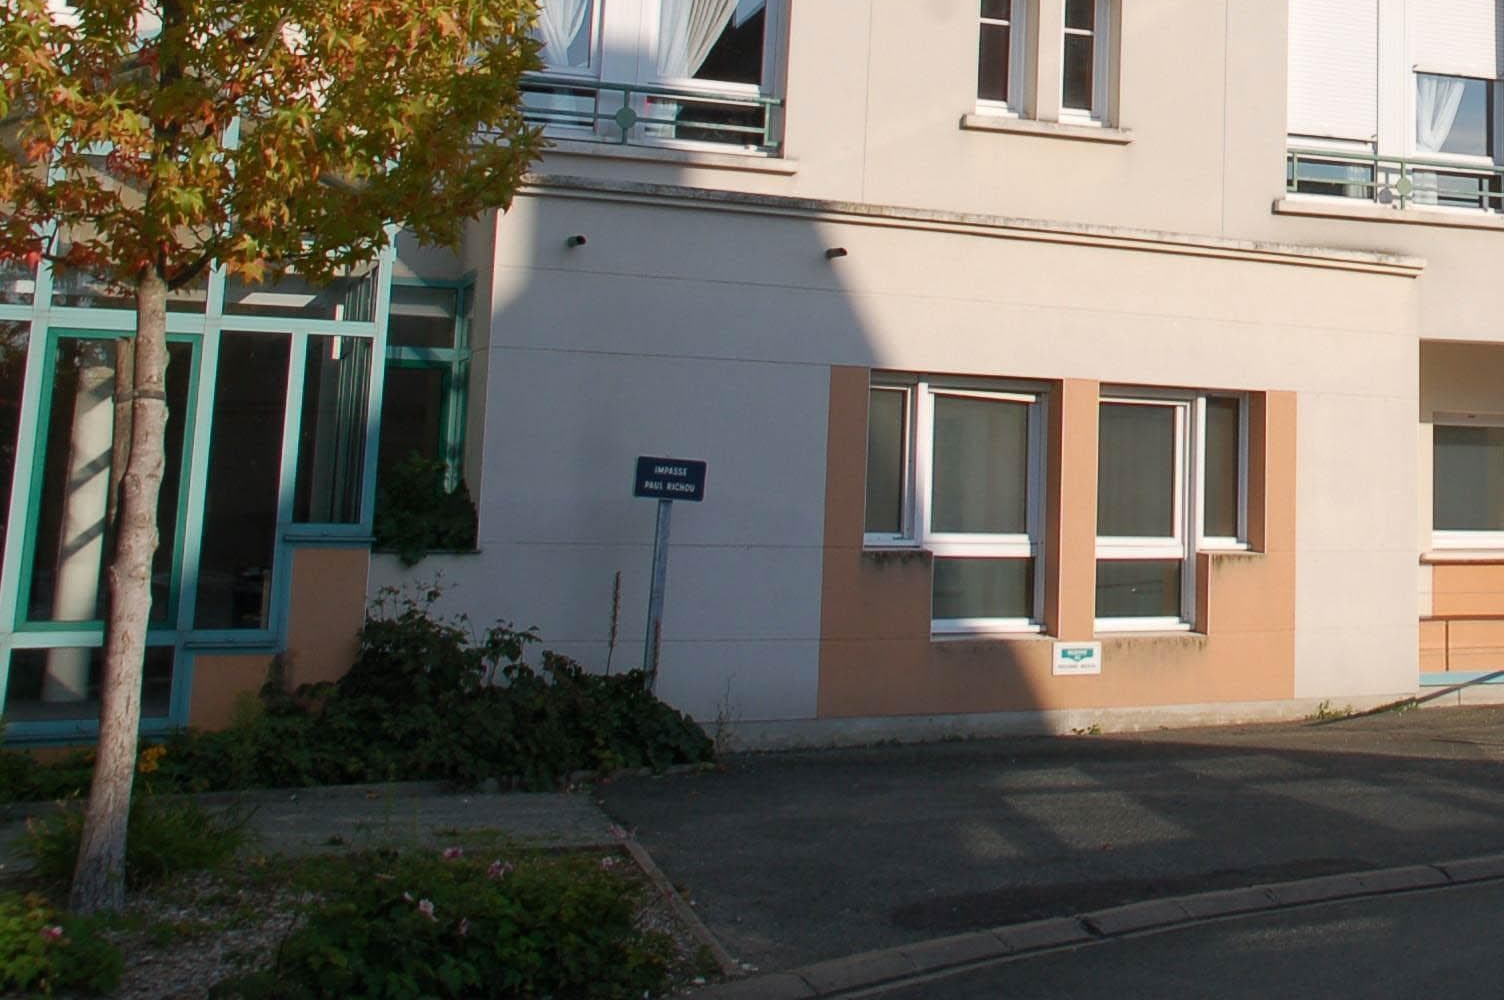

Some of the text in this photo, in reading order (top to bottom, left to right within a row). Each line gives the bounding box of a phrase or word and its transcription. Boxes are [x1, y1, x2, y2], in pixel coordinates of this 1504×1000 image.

[654, 465, 688, 476] IMPASSE
[644, 480, 696, 493] PAUL RICHOU
